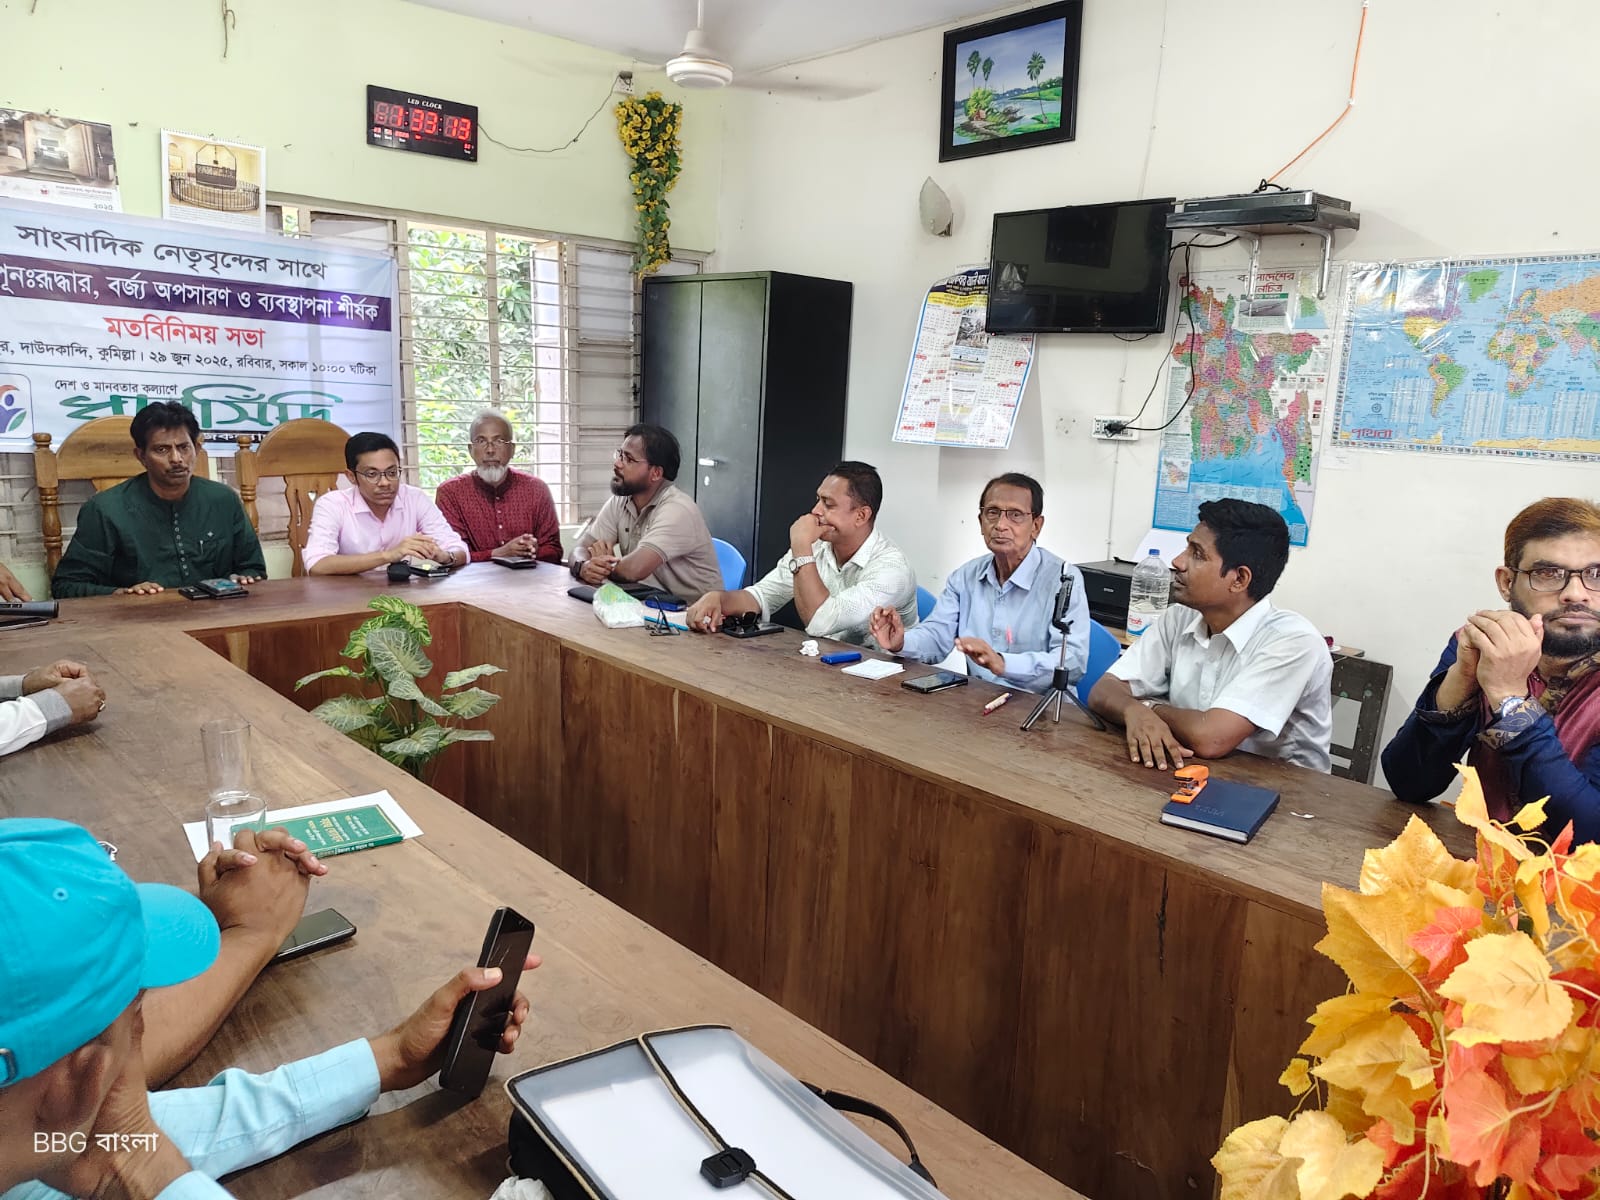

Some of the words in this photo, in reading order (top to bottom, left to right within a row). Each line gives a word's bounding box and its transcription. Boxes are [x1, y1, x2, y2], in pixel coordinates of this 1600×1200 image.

[407, 97, 420, 106] LED
[421, 100, 442, 110] CLOCK
[14, 225, 144, 257] সাংবাদিক
[154, 243, 270, 275] নেতৃবৃন্দের
[276, 258, 328, 280] সাথে
[1237, 272, 1295, 282] বলাদেশের
[105, 272, 148, 300] বর্জ্য
[152, 280, 232, 308] অপসারণ
[237, 289, 251, 309] ও
[256, 291, 333, 319] ব্যবস্থাপনা
[336, 294, 379, 322] শীর্ষক
[102, 313, 220, 346] মতবিনিময়
[225, 327, 265, 349] সভা
[19, 340, 93, 361] দাউদকান্দি,
[150, 351, 167, 364] ২৯
[170, 351, 191, 366] জুন
[195, 354, 233, 368] ২০২৫,
[236, 354, 276, 371] রবিবার,
[279, 359, 308, 373] সকাল
[349, 363, 377, 377] ঘটিকা
[54, 378, 77, 392] দেশ
[81, 380, 90, 391] ও
[93, 381, 138, 394] মানবতার
[141, 383, 178, 396] কল্যাণে
